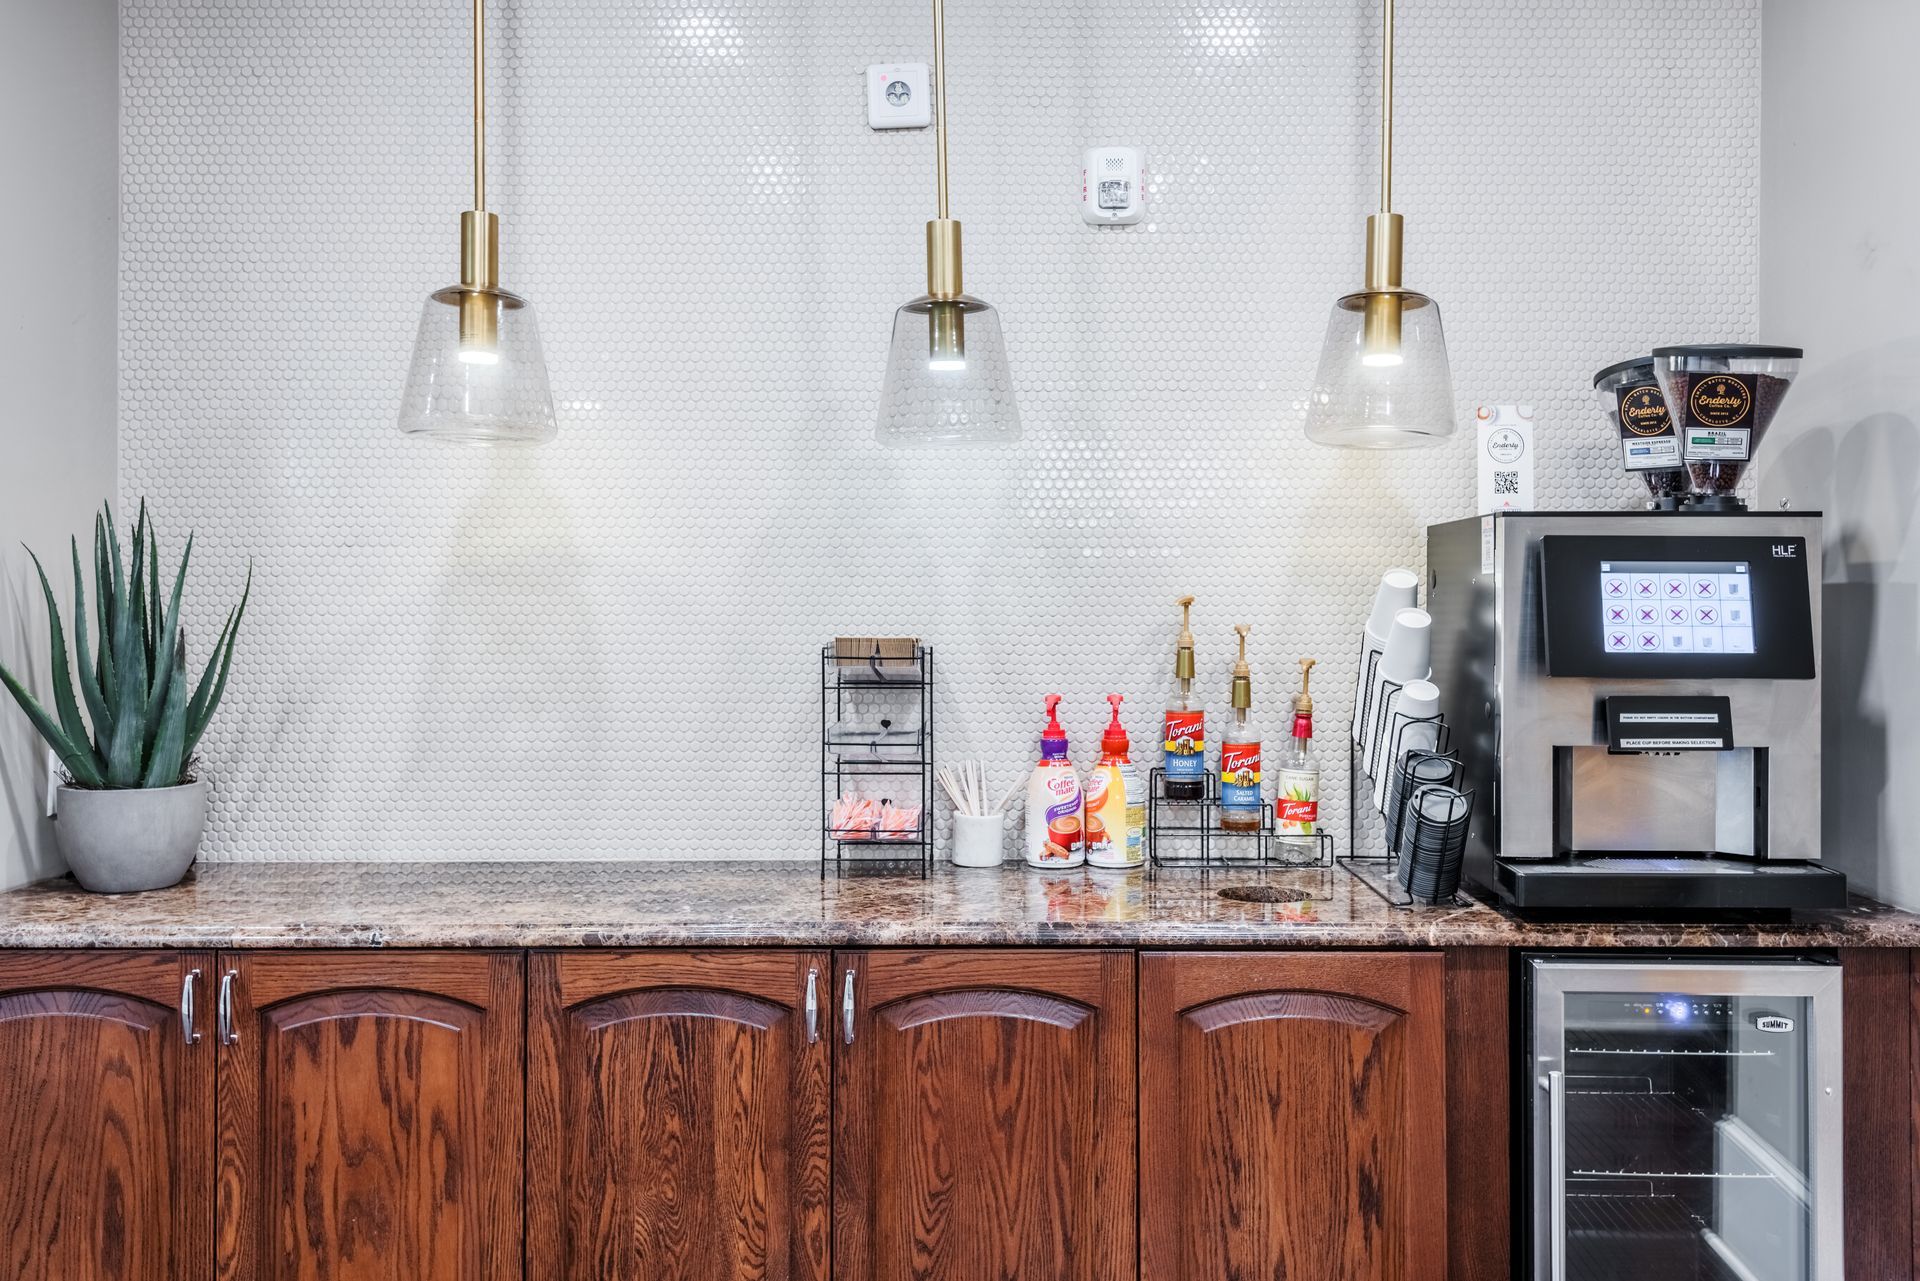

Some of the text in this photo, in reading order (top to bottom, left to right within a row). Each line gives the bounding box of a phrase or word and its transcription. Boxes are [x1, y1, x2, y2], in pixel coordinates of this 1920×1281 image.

[1698, 394, 1742, 408] Enderly
[1628, 405, 1666, 417] Enderly
[1492, 442, 1519, 450] Enderly
[1772, 544, 1796, 555] HLF
[1166, 718, 1203, 742] Torani
[1172, 758, 1198, 768] HONEY
[1224, 750, 1261, 774] Torani
[1047, 778, 1075, 791] Coffee
[1056, 786, 1075, 796] mate
[1282, 803, 1313, 819] Torani
[1762, 1020, 1789, 1030] SUMMIT
